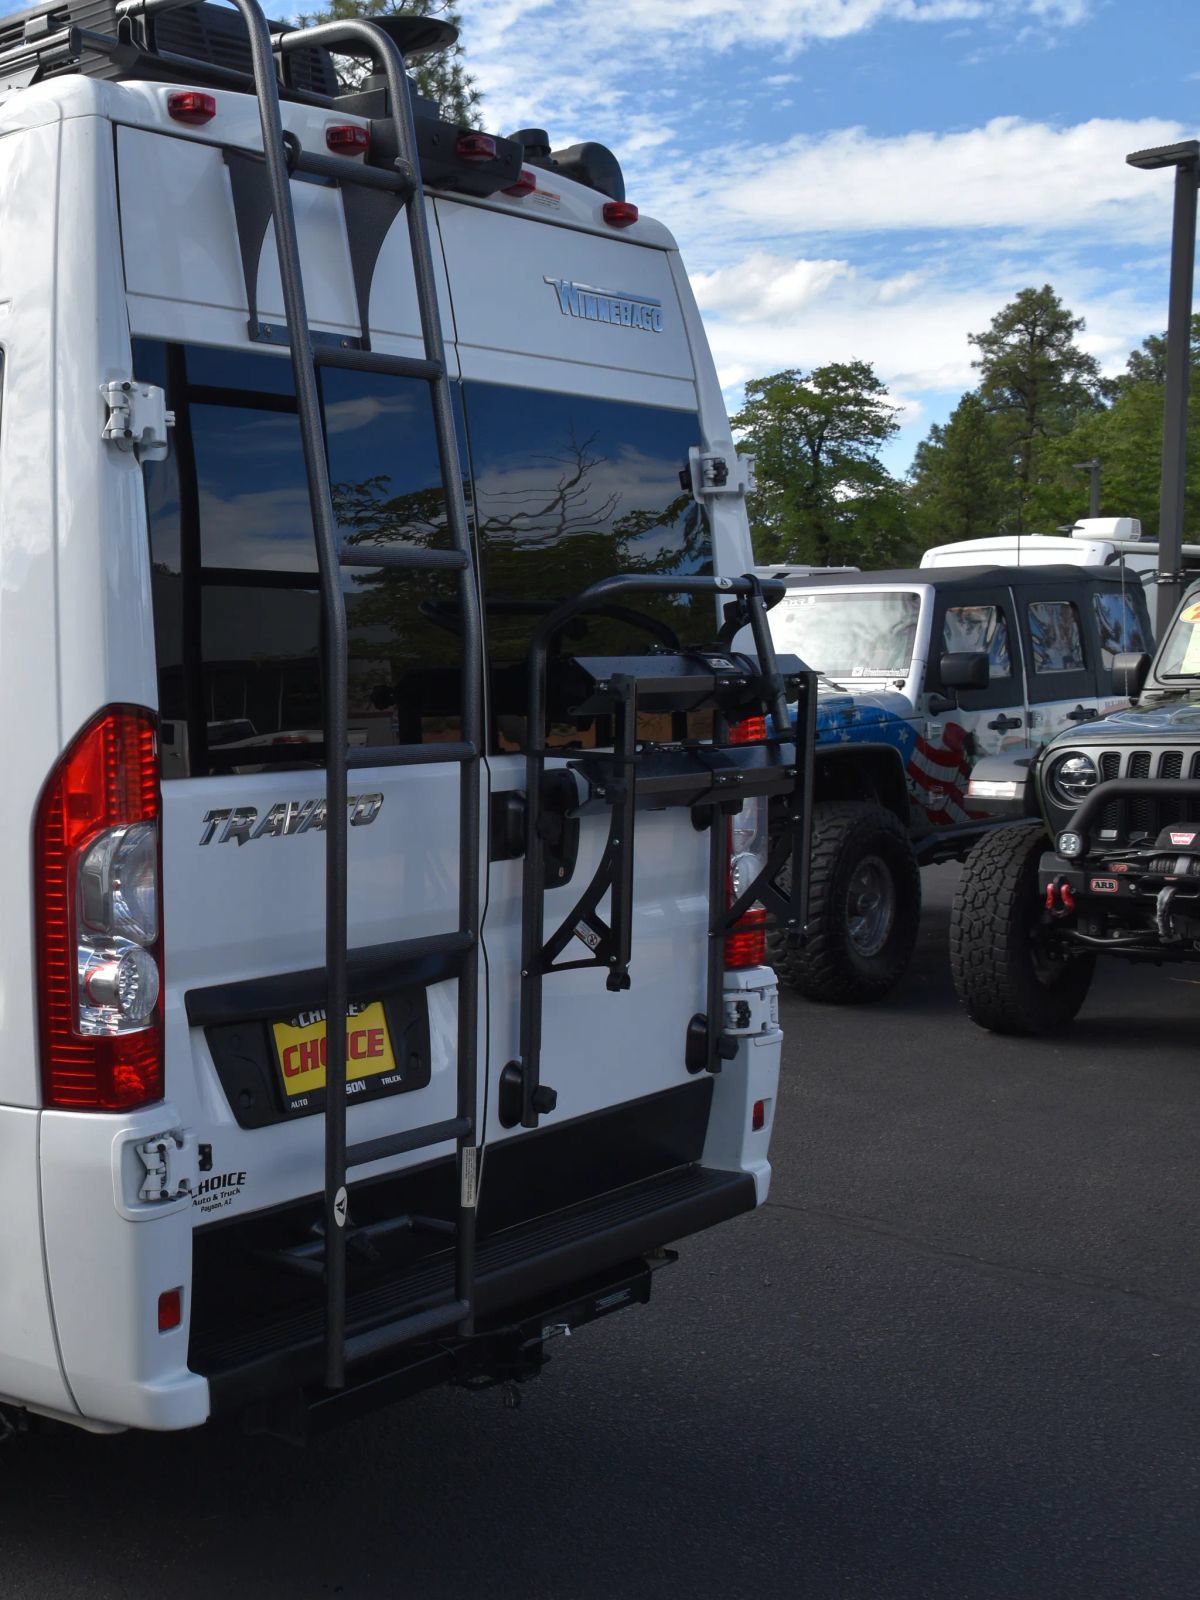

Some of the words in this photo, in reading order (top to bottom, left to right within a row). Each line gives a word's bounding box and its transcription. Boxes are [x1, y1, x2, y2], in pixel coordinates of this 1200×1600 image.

[543, 275, 664, 333] WINNEBAGO
[199, 792, 384, 847] TRAVAO
[1094, 880, 1115, 889] ARB
[298, 1003, 359, 1027] CHE
[345, 1080, 367, 1095] SON
[380, 1075, 402, 1085] TRUCK
[290, 1098, 308, 1109] AUTO
[192, 1197, 211, 1207] Auto
[220, 1187, 241, 1198] Truck
[200, 1202, 224, 1213] Payson,
